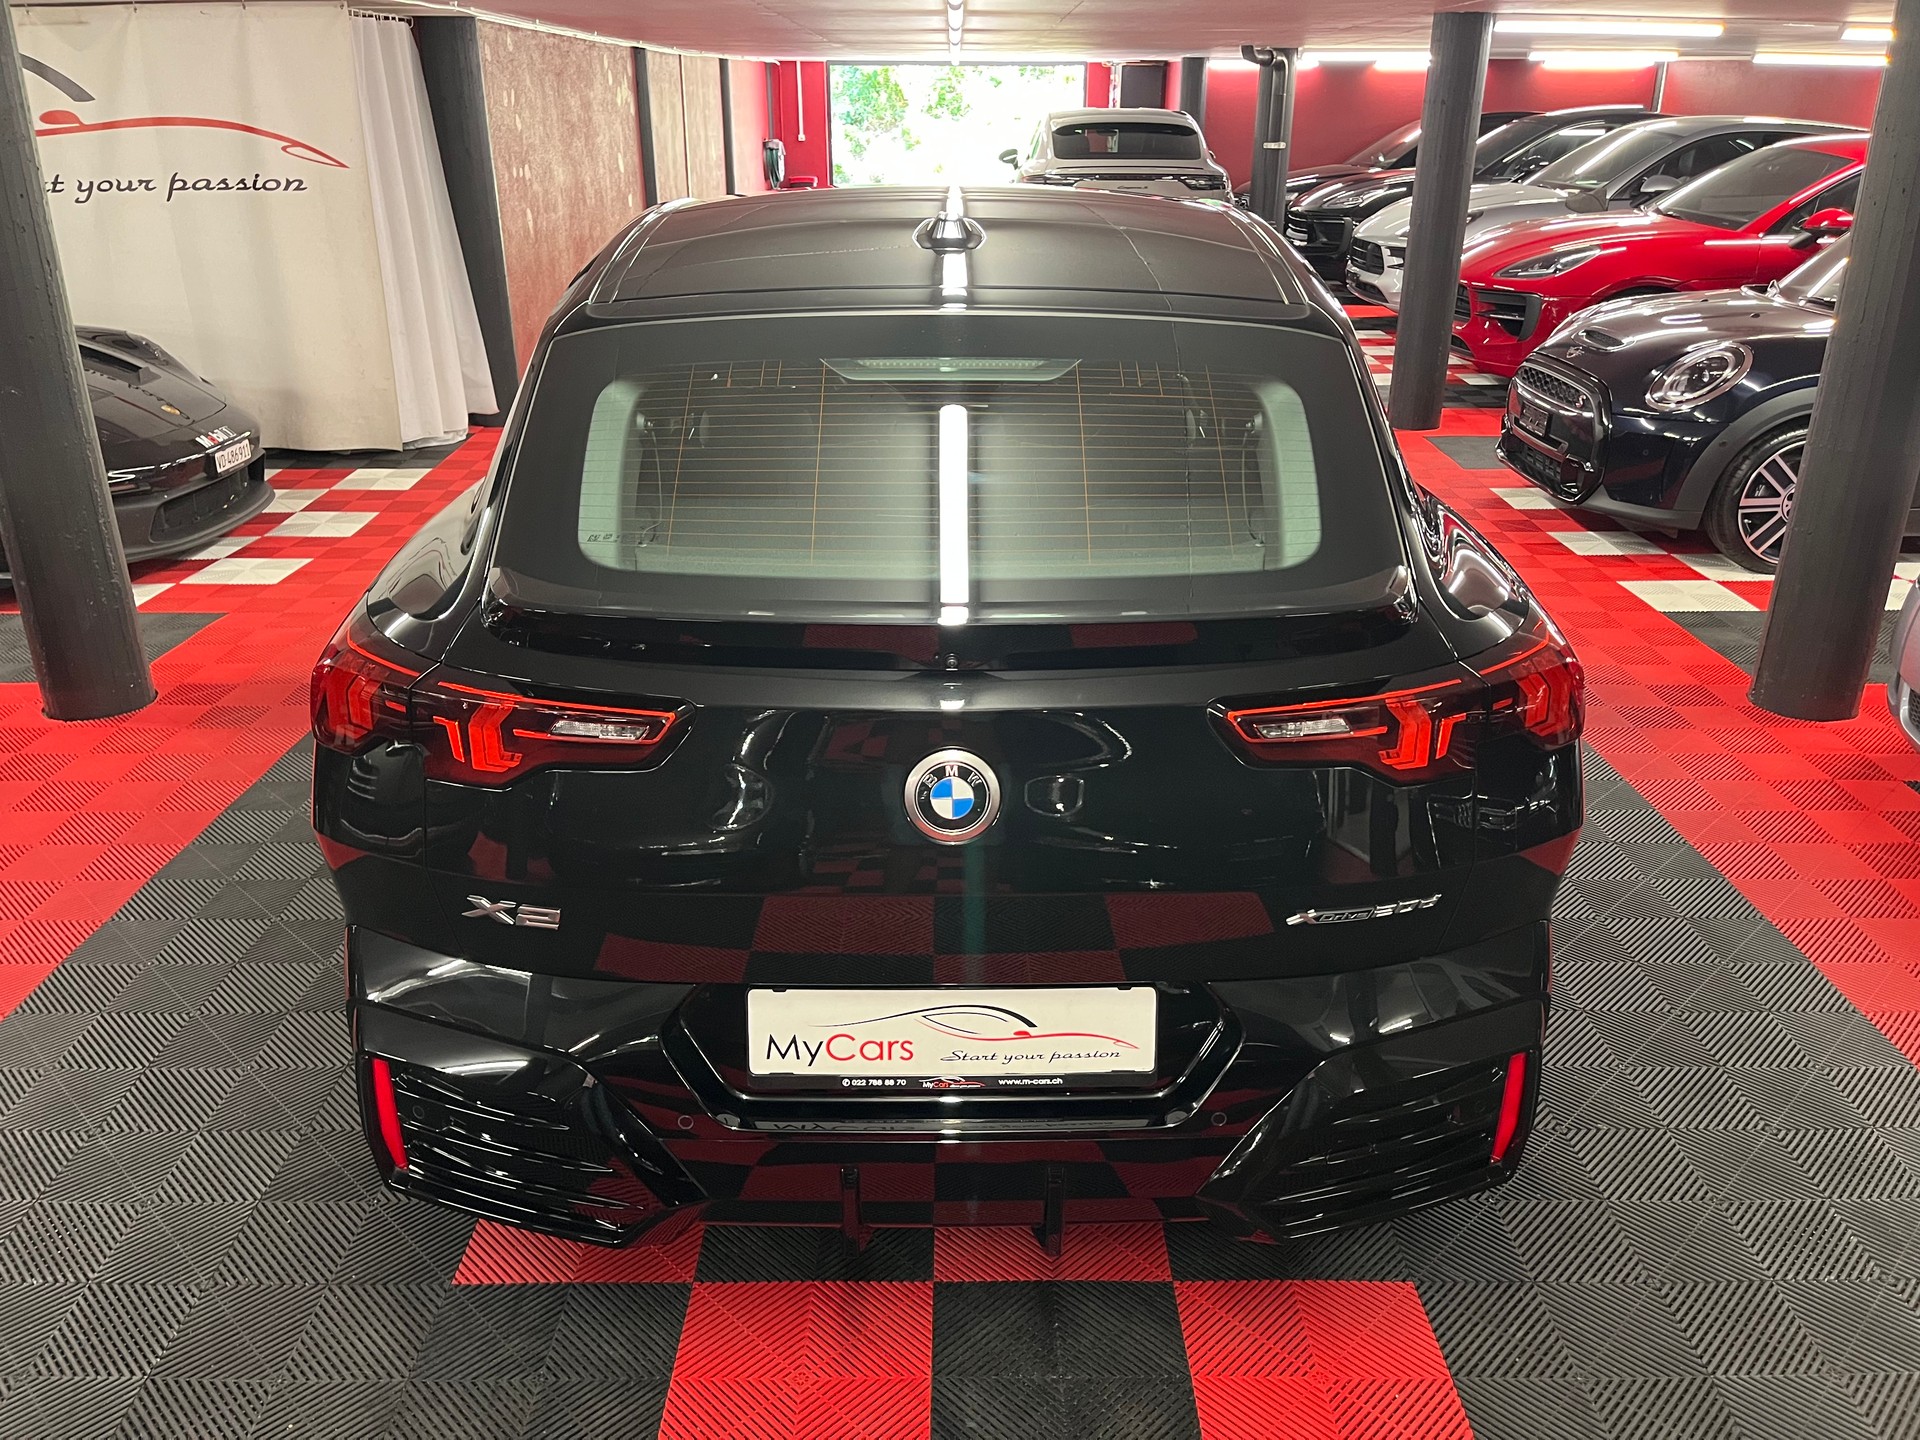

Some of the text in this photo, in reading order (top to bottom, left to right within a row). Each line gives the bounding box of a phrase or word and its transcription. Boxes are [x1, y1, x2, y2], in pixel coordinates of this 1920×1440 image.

[74, 178, 157, 204] your
[166, 172, 308, 203] passion
[923, 764, 983, 788] BMW
[461, 894, 561, 931] X2
[766, 1033, 914, 1067] MyCars
[940, 1050, 1121, 1065] Start your passion
